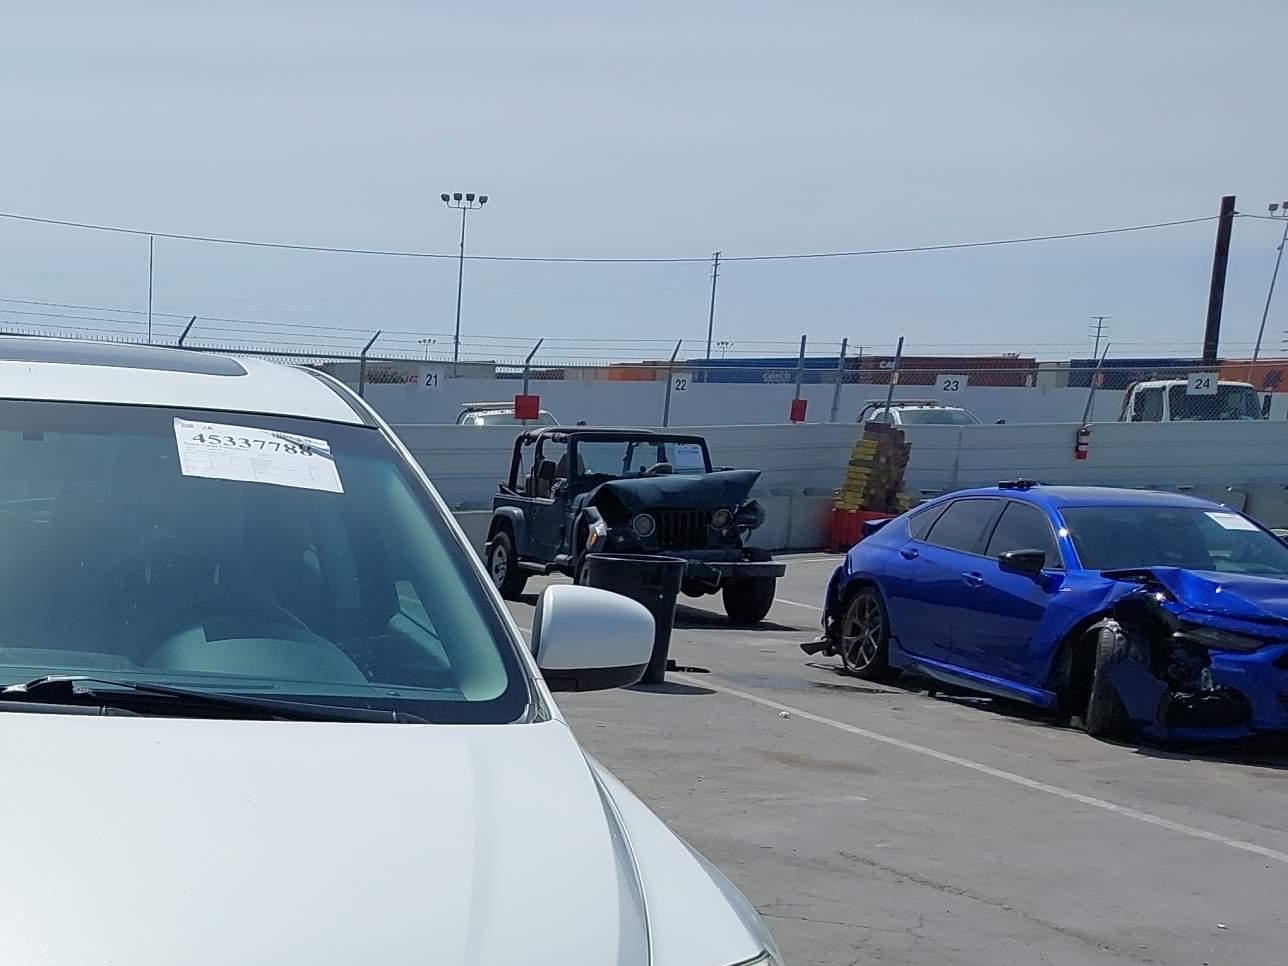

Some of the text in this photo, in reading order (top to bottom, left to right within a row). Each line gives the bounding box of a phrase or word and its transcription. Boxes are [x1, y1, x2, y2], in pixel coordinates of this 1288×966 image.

[425, 373, 439, 388] 21
[675, 378, 687, 391] 22
[943, 379, 960, 392] 23
[1194, 378, 1211, 390] 24
[192, 432, 314, 457] 45337788
